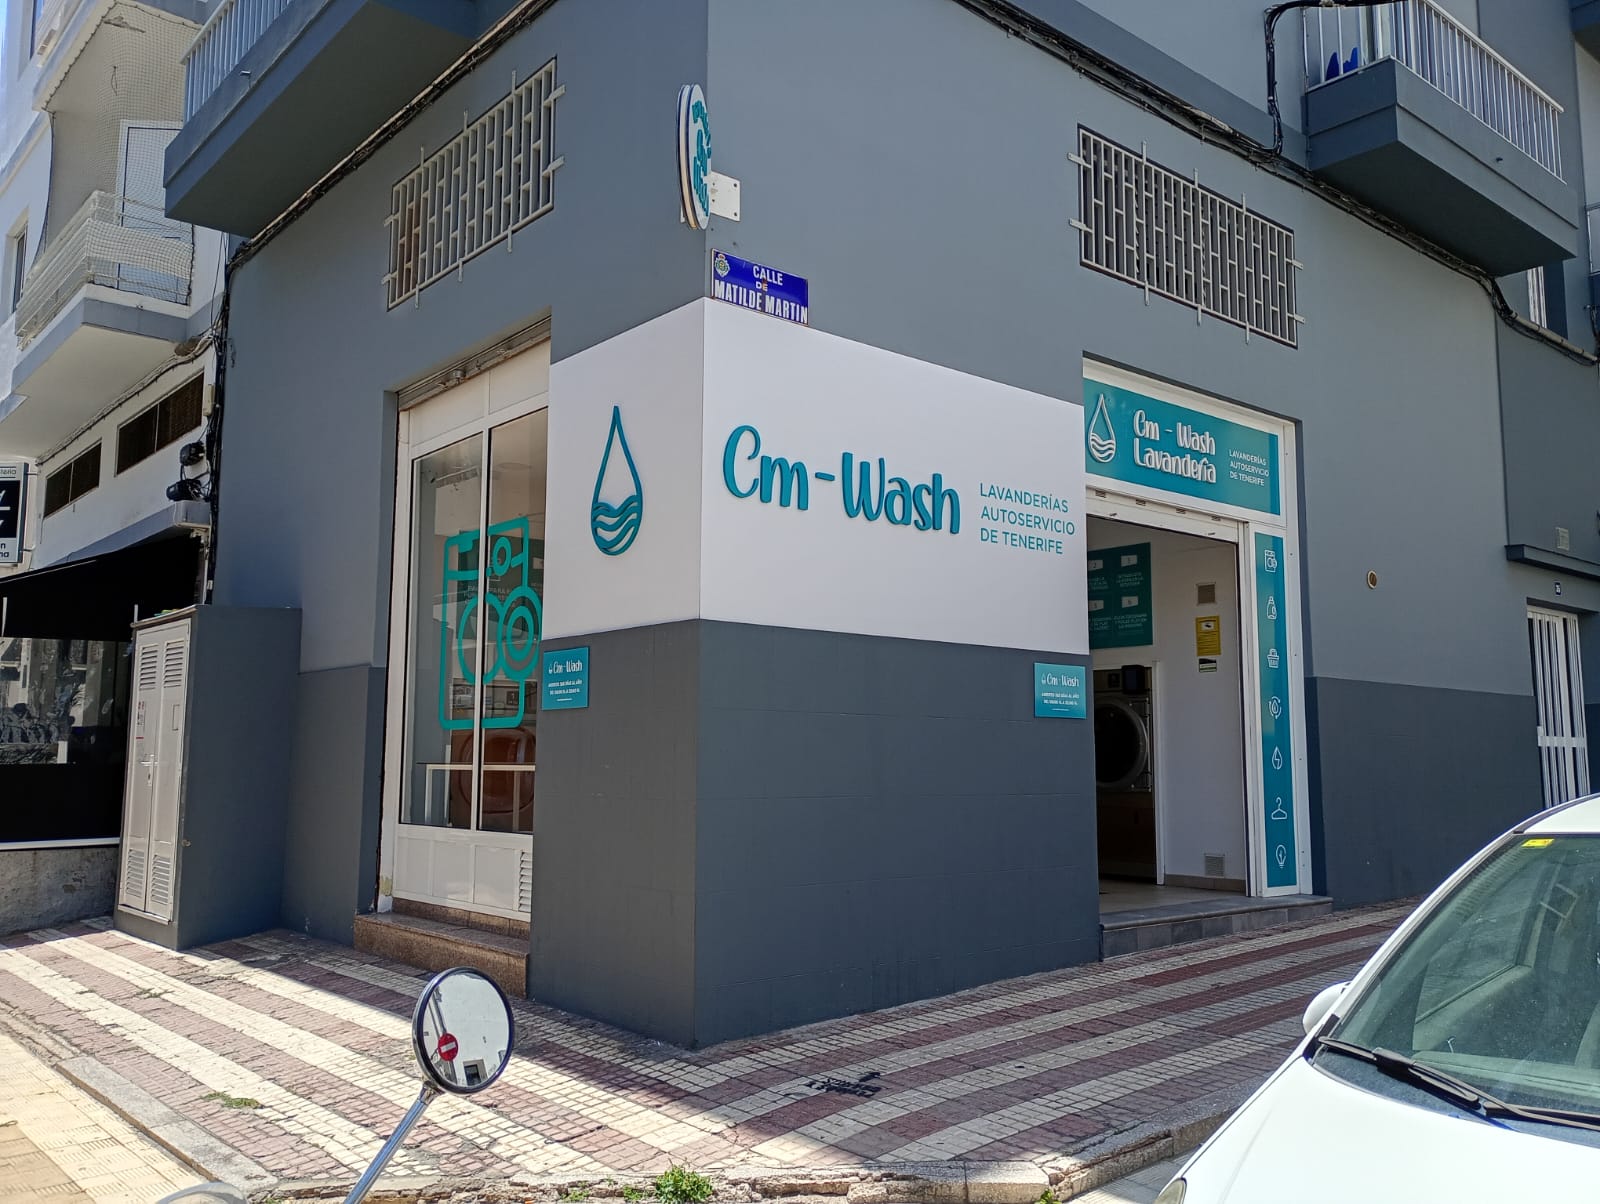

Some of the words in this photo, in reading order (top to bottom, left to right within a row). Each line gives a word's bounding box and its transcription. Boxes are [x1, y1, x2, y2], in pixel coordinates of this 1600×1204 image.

[752, 265, 783, 286] CALLE
[755, 281, 768, 292] DE
[714, 279, 762, 311] MATILDE
[765, 295, 808, 324] MARTIN
[1176, 422, 1216, 456] Wash
[1133, 437, 1217, 484] Lavandería
[1229, 449, 1267, 466] LAVANDERÍAS
[1230, 460, 1270, 477] AUTOSERVICIO
[1230, 471, 1239, 480] DE
[1239, 473, 1265, 486] TENERIFE
[979, 482, 1069, 513] LAVANDERÍAS
[980, 505, 1075, 536] AUTOSERVICIO
[979, 527, 998, 544] DE
[1002, 531, 1063, 555] TENERIFE
